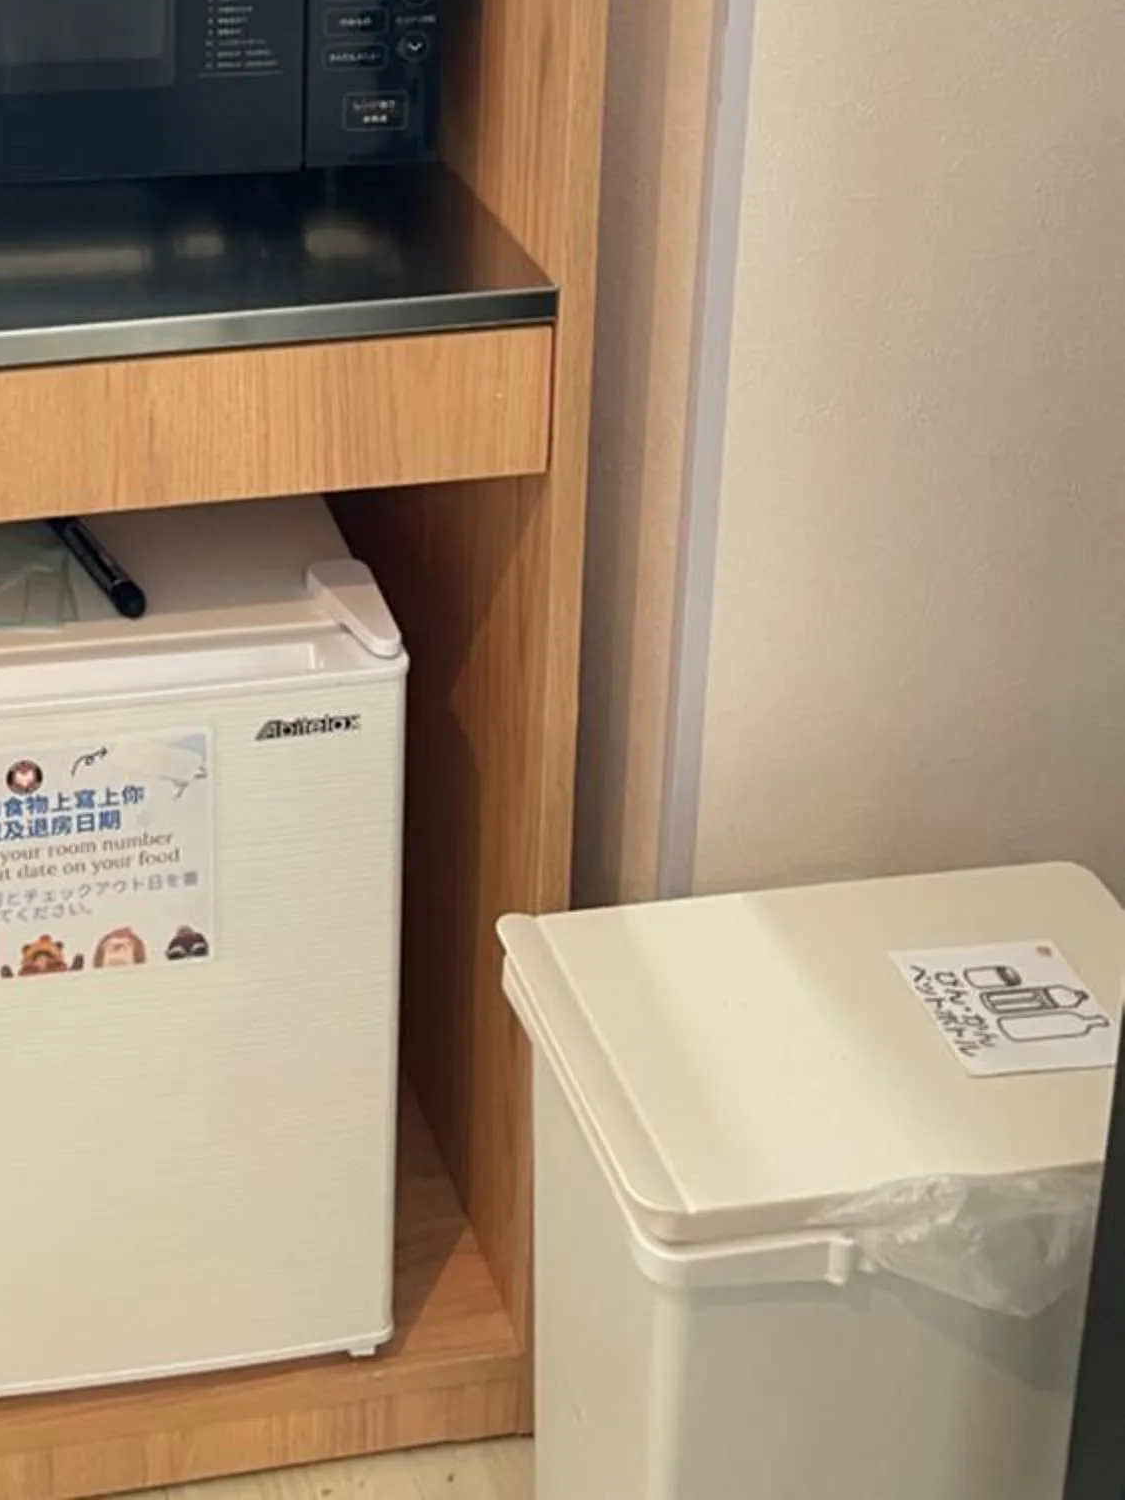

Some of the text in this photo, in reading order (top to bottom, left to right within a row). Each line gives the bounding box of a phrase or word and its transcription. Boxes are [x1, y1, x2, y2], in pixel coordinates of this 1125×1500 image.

[254, 712, 361, 741] Abitelax
[0, 846, 41, 867] your
[46, 841, 97, 859] room
[102, 831, 174, 853] number
[17, 861, 57, 880] date
[63, 860, 87, 876] on
[90, 855, 132, 876] your
[138, 848, 181, 867] food
